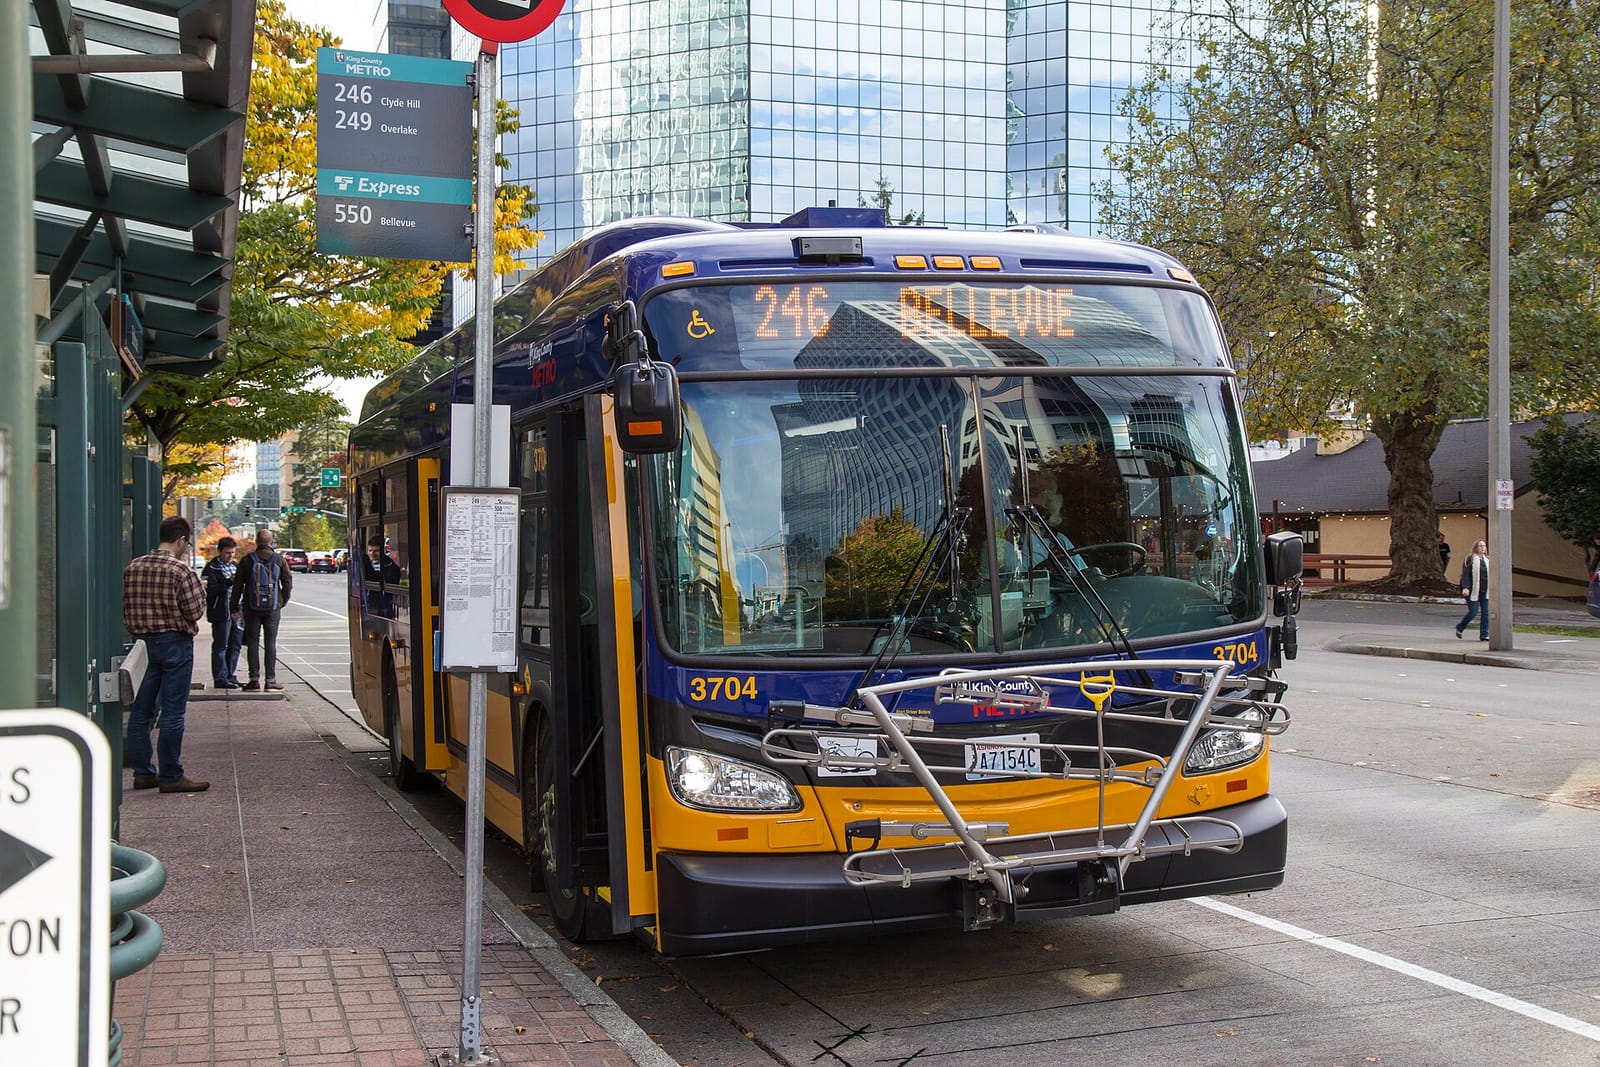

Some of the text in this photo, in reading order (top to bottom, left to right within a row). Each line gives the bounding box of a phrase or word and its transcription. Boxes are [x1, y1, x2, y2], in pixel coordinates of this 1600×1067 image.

[346, 55, 383, 66] King County
[346, 64, 391, 77] METRO
[335, 83, 421, 109] 246 Clyde Hill
[335, 110, 418, 135] 249 Overlake
[358, 177, 420, 197] Express
[335, 204, 416, 228] 550 Bellevue
[755, 285, 1076, 338] 246 BELLEVUE
[533, 358, 555, 388] METRO
[533, 446, 547, 473] 370
[1213, 641, 1258, 665] 3704
[690, 676, 758, 701] 3704
[998, 680, 1034, 692] County
[981, 748, 1036, 770] A7154C
[0, 917, 61, 957] ON
